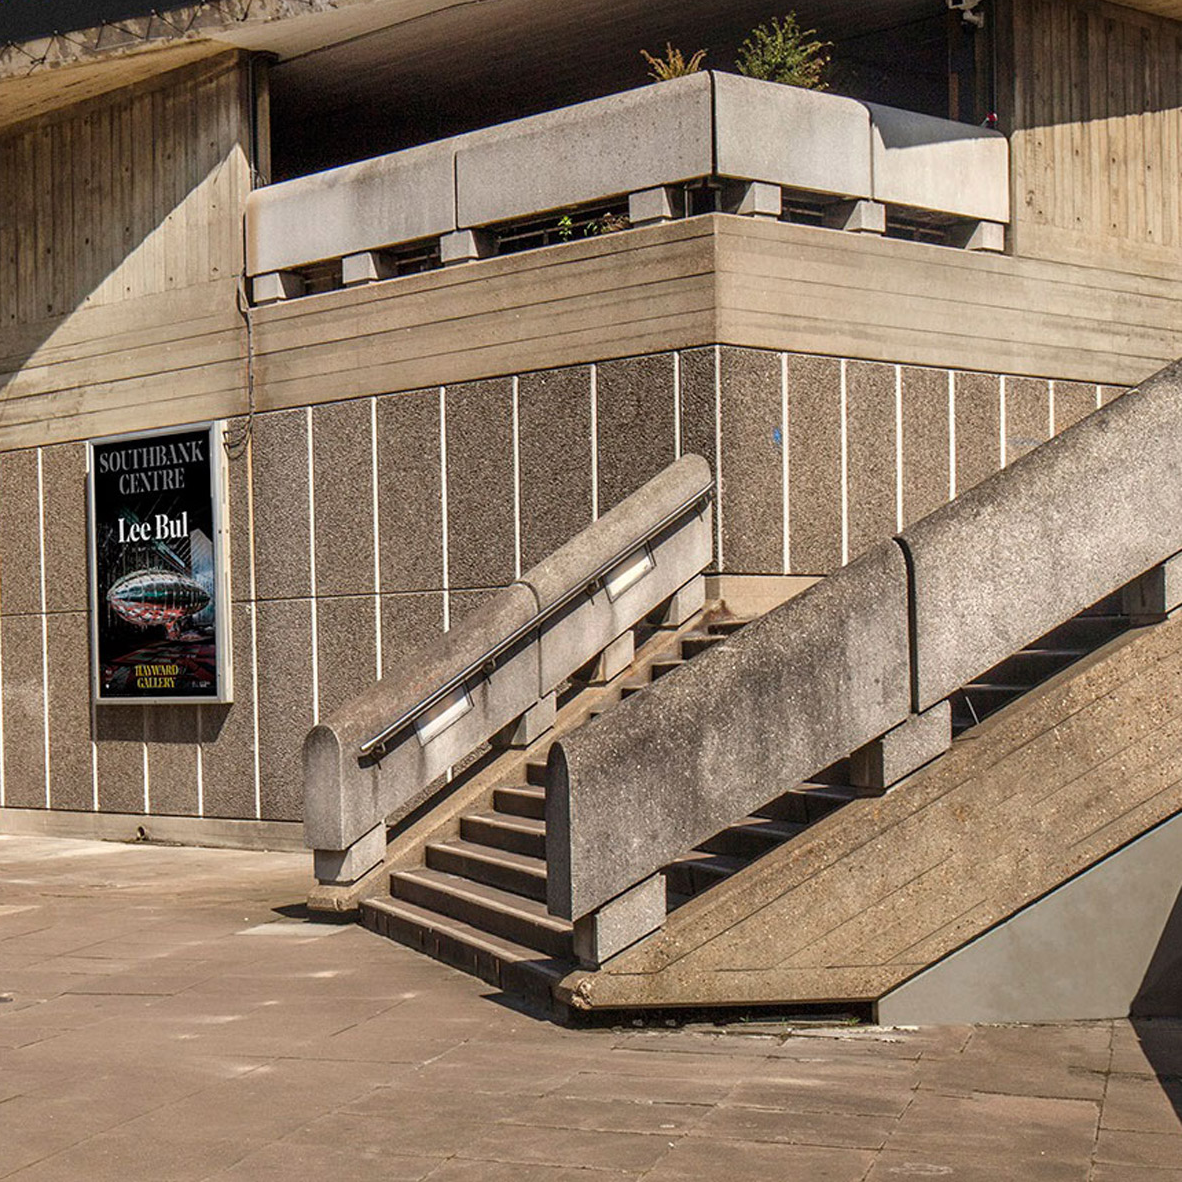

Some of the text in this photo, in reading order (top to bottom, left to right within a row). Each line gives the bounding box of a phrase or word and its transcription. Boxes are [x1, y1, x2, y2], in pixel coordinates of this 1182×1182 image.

[99, 440, 205, 474] SOUTHBANK
[119, 468, 185, 495] CENTRE
[118, 511, 188, 543] Lee Bul
[134, 664, 179, 677] HAYWARD
[136, 676, 177, 689] GALLERY
